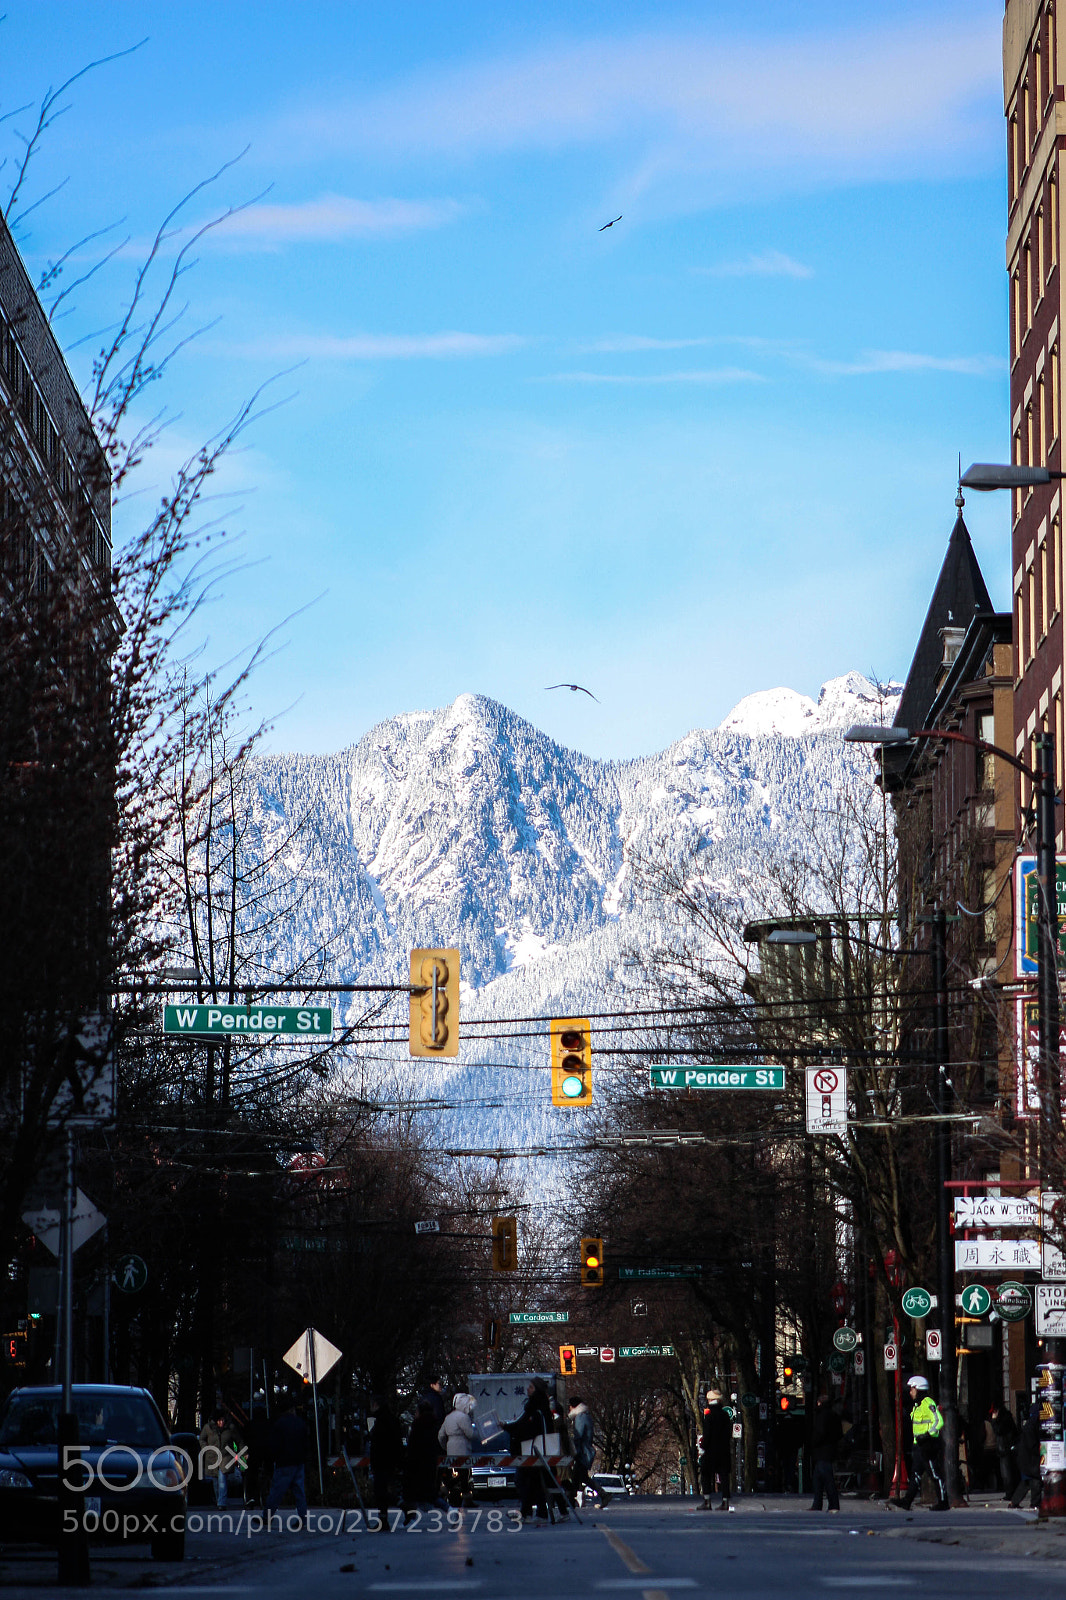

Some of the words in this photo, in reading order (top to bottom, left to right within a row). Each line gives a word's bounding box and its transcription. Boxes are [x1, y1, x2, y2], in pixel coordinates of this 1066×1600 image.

[176, 1009, 198, 1028] W
[207, 1009, 286, 1029] Pender
[296, 1011, 321, 1030] St
[660, 1070, 677, 1084] W
[685, 1070, 748, 1085] Pender
[755, 1070, 775, 1085] St
[970, 1204, 995, 1215] JACK
[1016, 1204, 1038, 1215] CHO
[624, 1268, 634, 1276] W
[1045, 1298, 1065, 1306] LINE
[513, 1314, 521, 1322] W
[523, 1313, 554, 1321] Cordova
[556, 1313, 565, 1321] St
[622, 1348, 630, 1356] W
